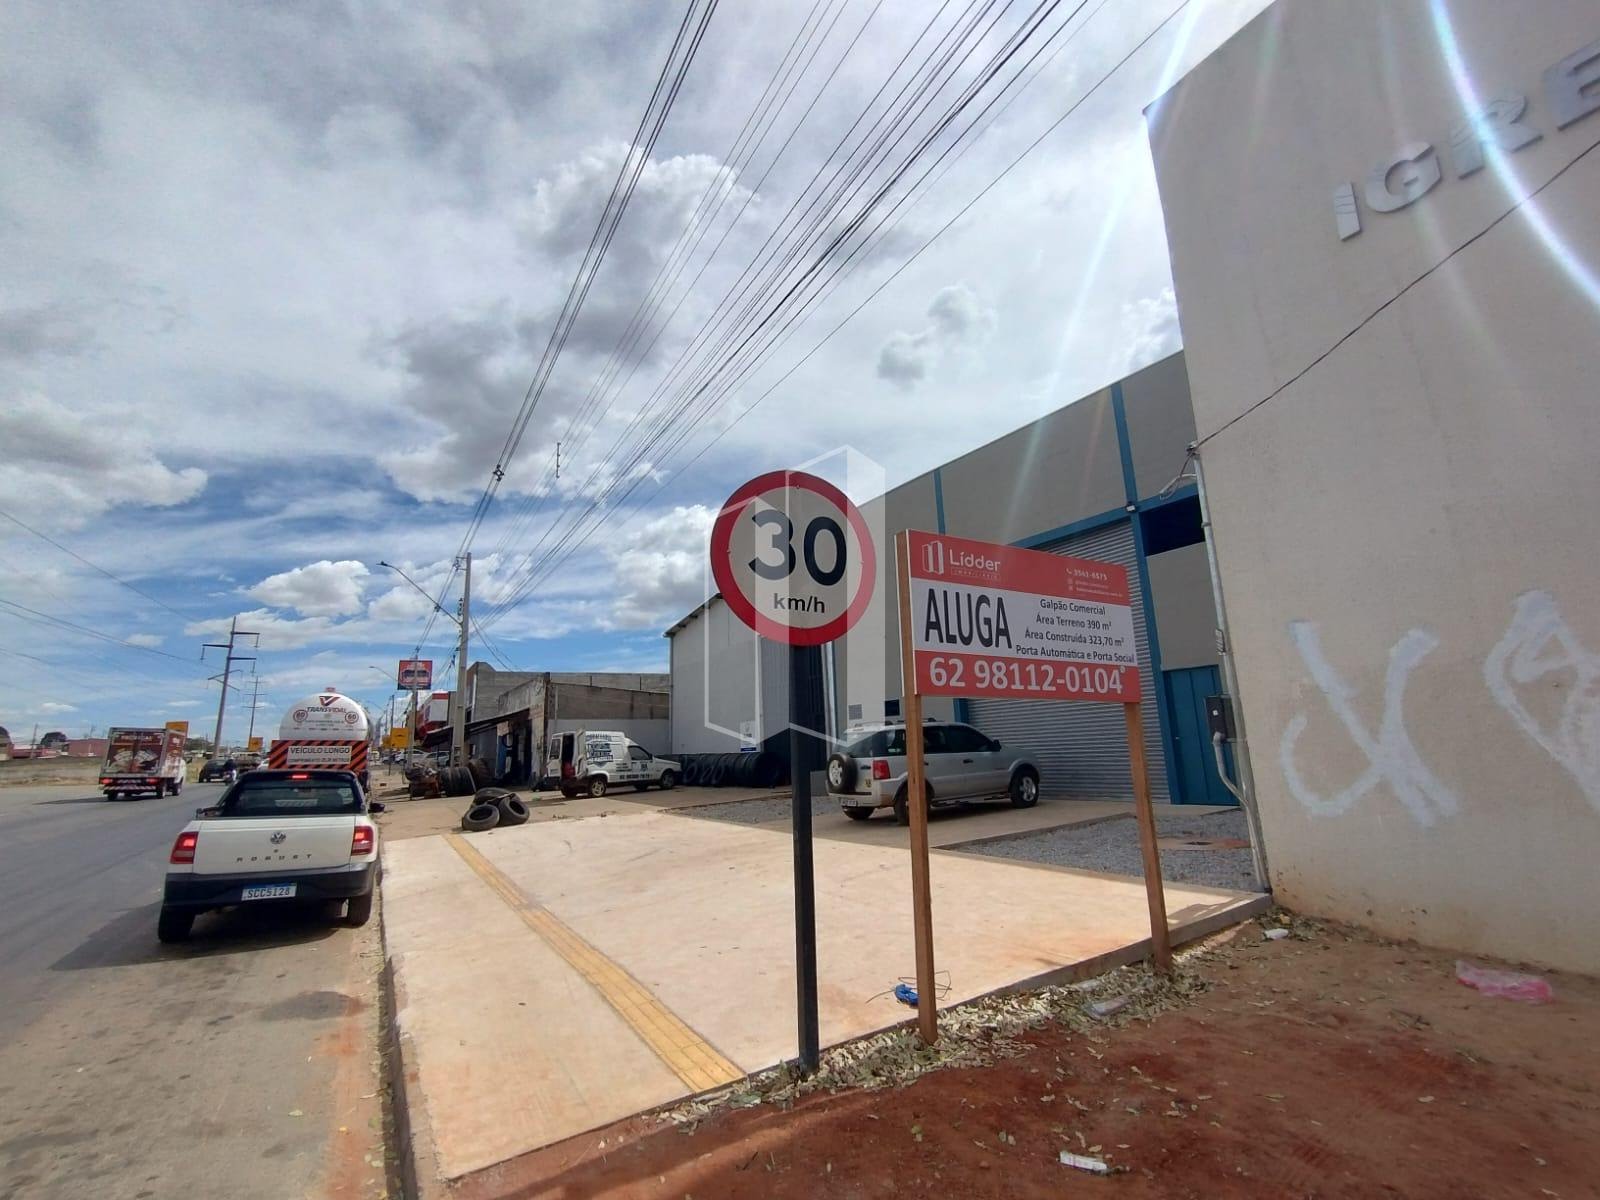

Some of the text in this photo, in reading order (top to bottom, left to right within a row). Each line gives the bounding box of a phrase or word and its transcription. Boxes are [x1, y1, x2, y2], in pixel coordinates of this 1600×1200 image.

[748, 508, 847, 586] 30
[949, 548, 1001, 572] Lídder
[773, 592, 825, 614] km/h
[1040, 598, 1106, 615] Galpão Comercial
[924, 588, 1012, 649] ALUGA
[1036, 612, 1055, 625] Área
[1056, 616, 1085, 628] Terreno
[1087, 619, 1101, 630] 390
[1045, 631, 1087, 644] Construída
[1089, 635, 1113, 646] 323,70
[1016, 644, 1038, 655] Porta
[1040, 646, 1085, 659] Automática
[1092, 652, 1112, 661] Porta
[1114, 653, 1134, 663] Social
[929, 657, 1122, 694] 62 98112-0104
